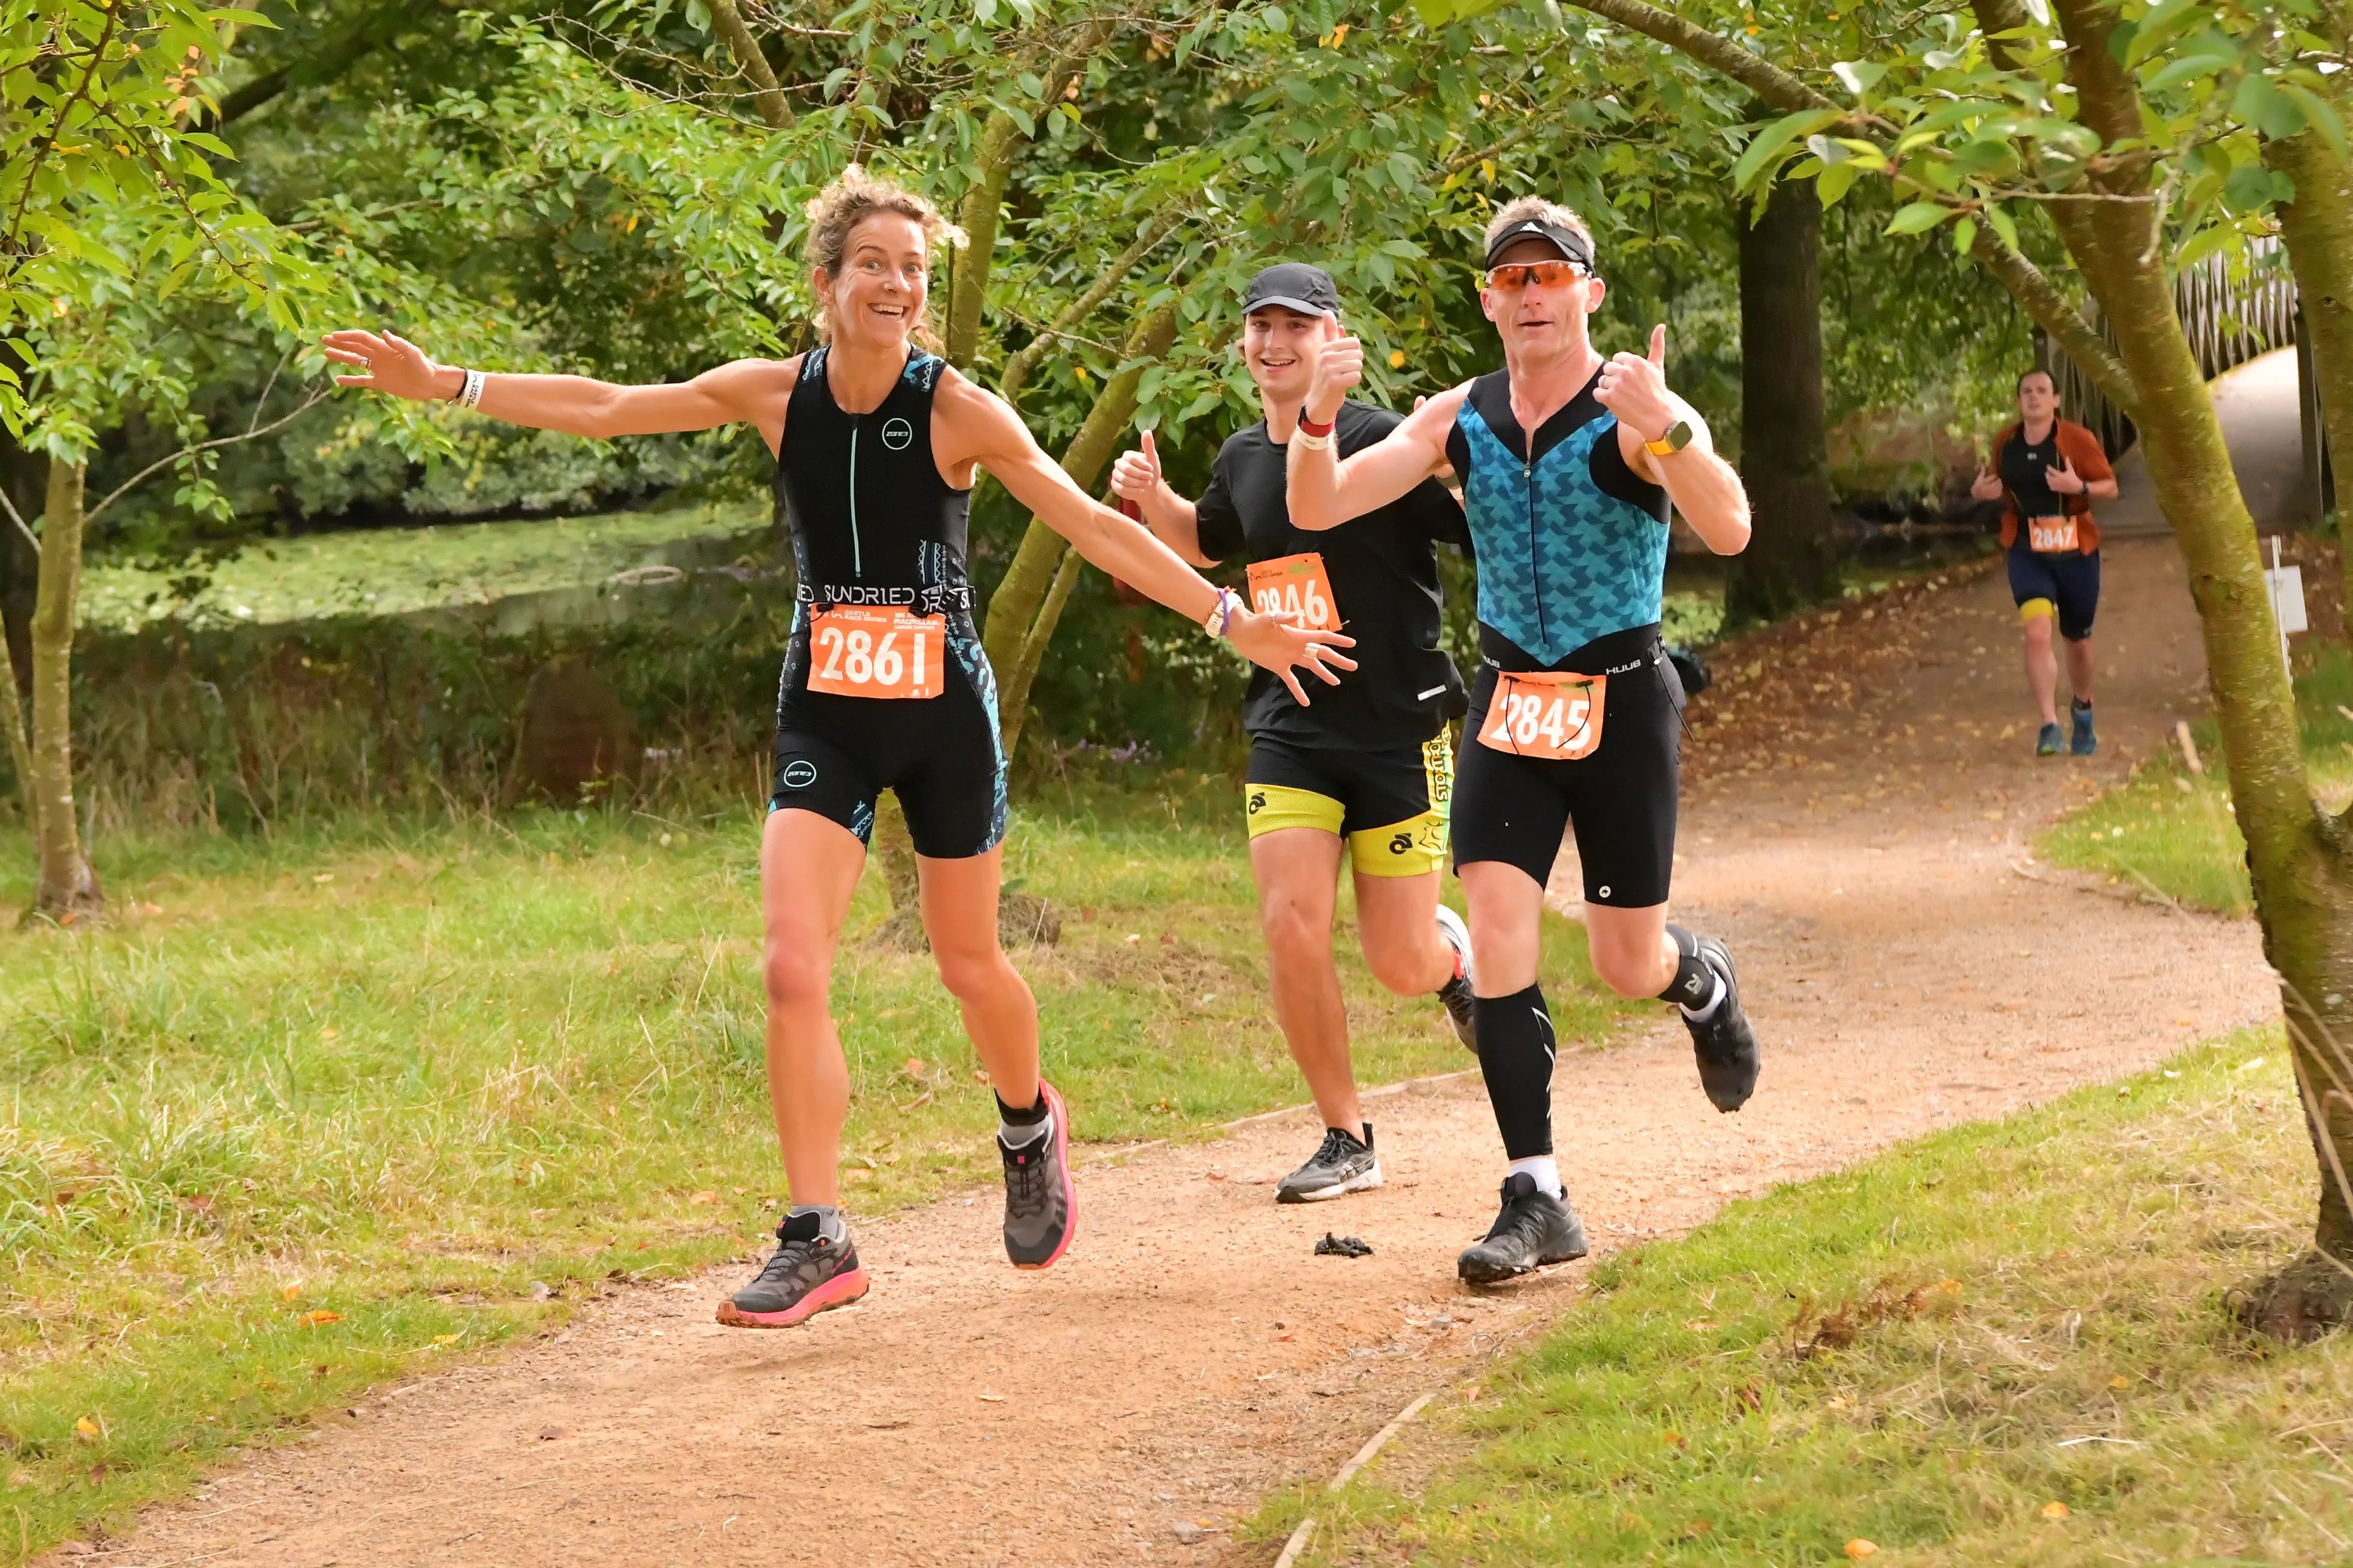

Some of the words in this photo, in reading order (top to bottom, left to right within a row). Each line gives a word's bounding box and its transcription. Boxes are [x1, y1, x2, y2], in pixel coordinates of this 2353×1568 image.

[470, 385, 479, 404] CASTLE
[2034, 527, 2073, 549] 2847
[824, 584, 915, 605] SUNDRIED
[820, 627, 925, 685] 2861
[1606, 659, 1641, 675] HUUB
[1489, 693, 1591, 750] 2845
